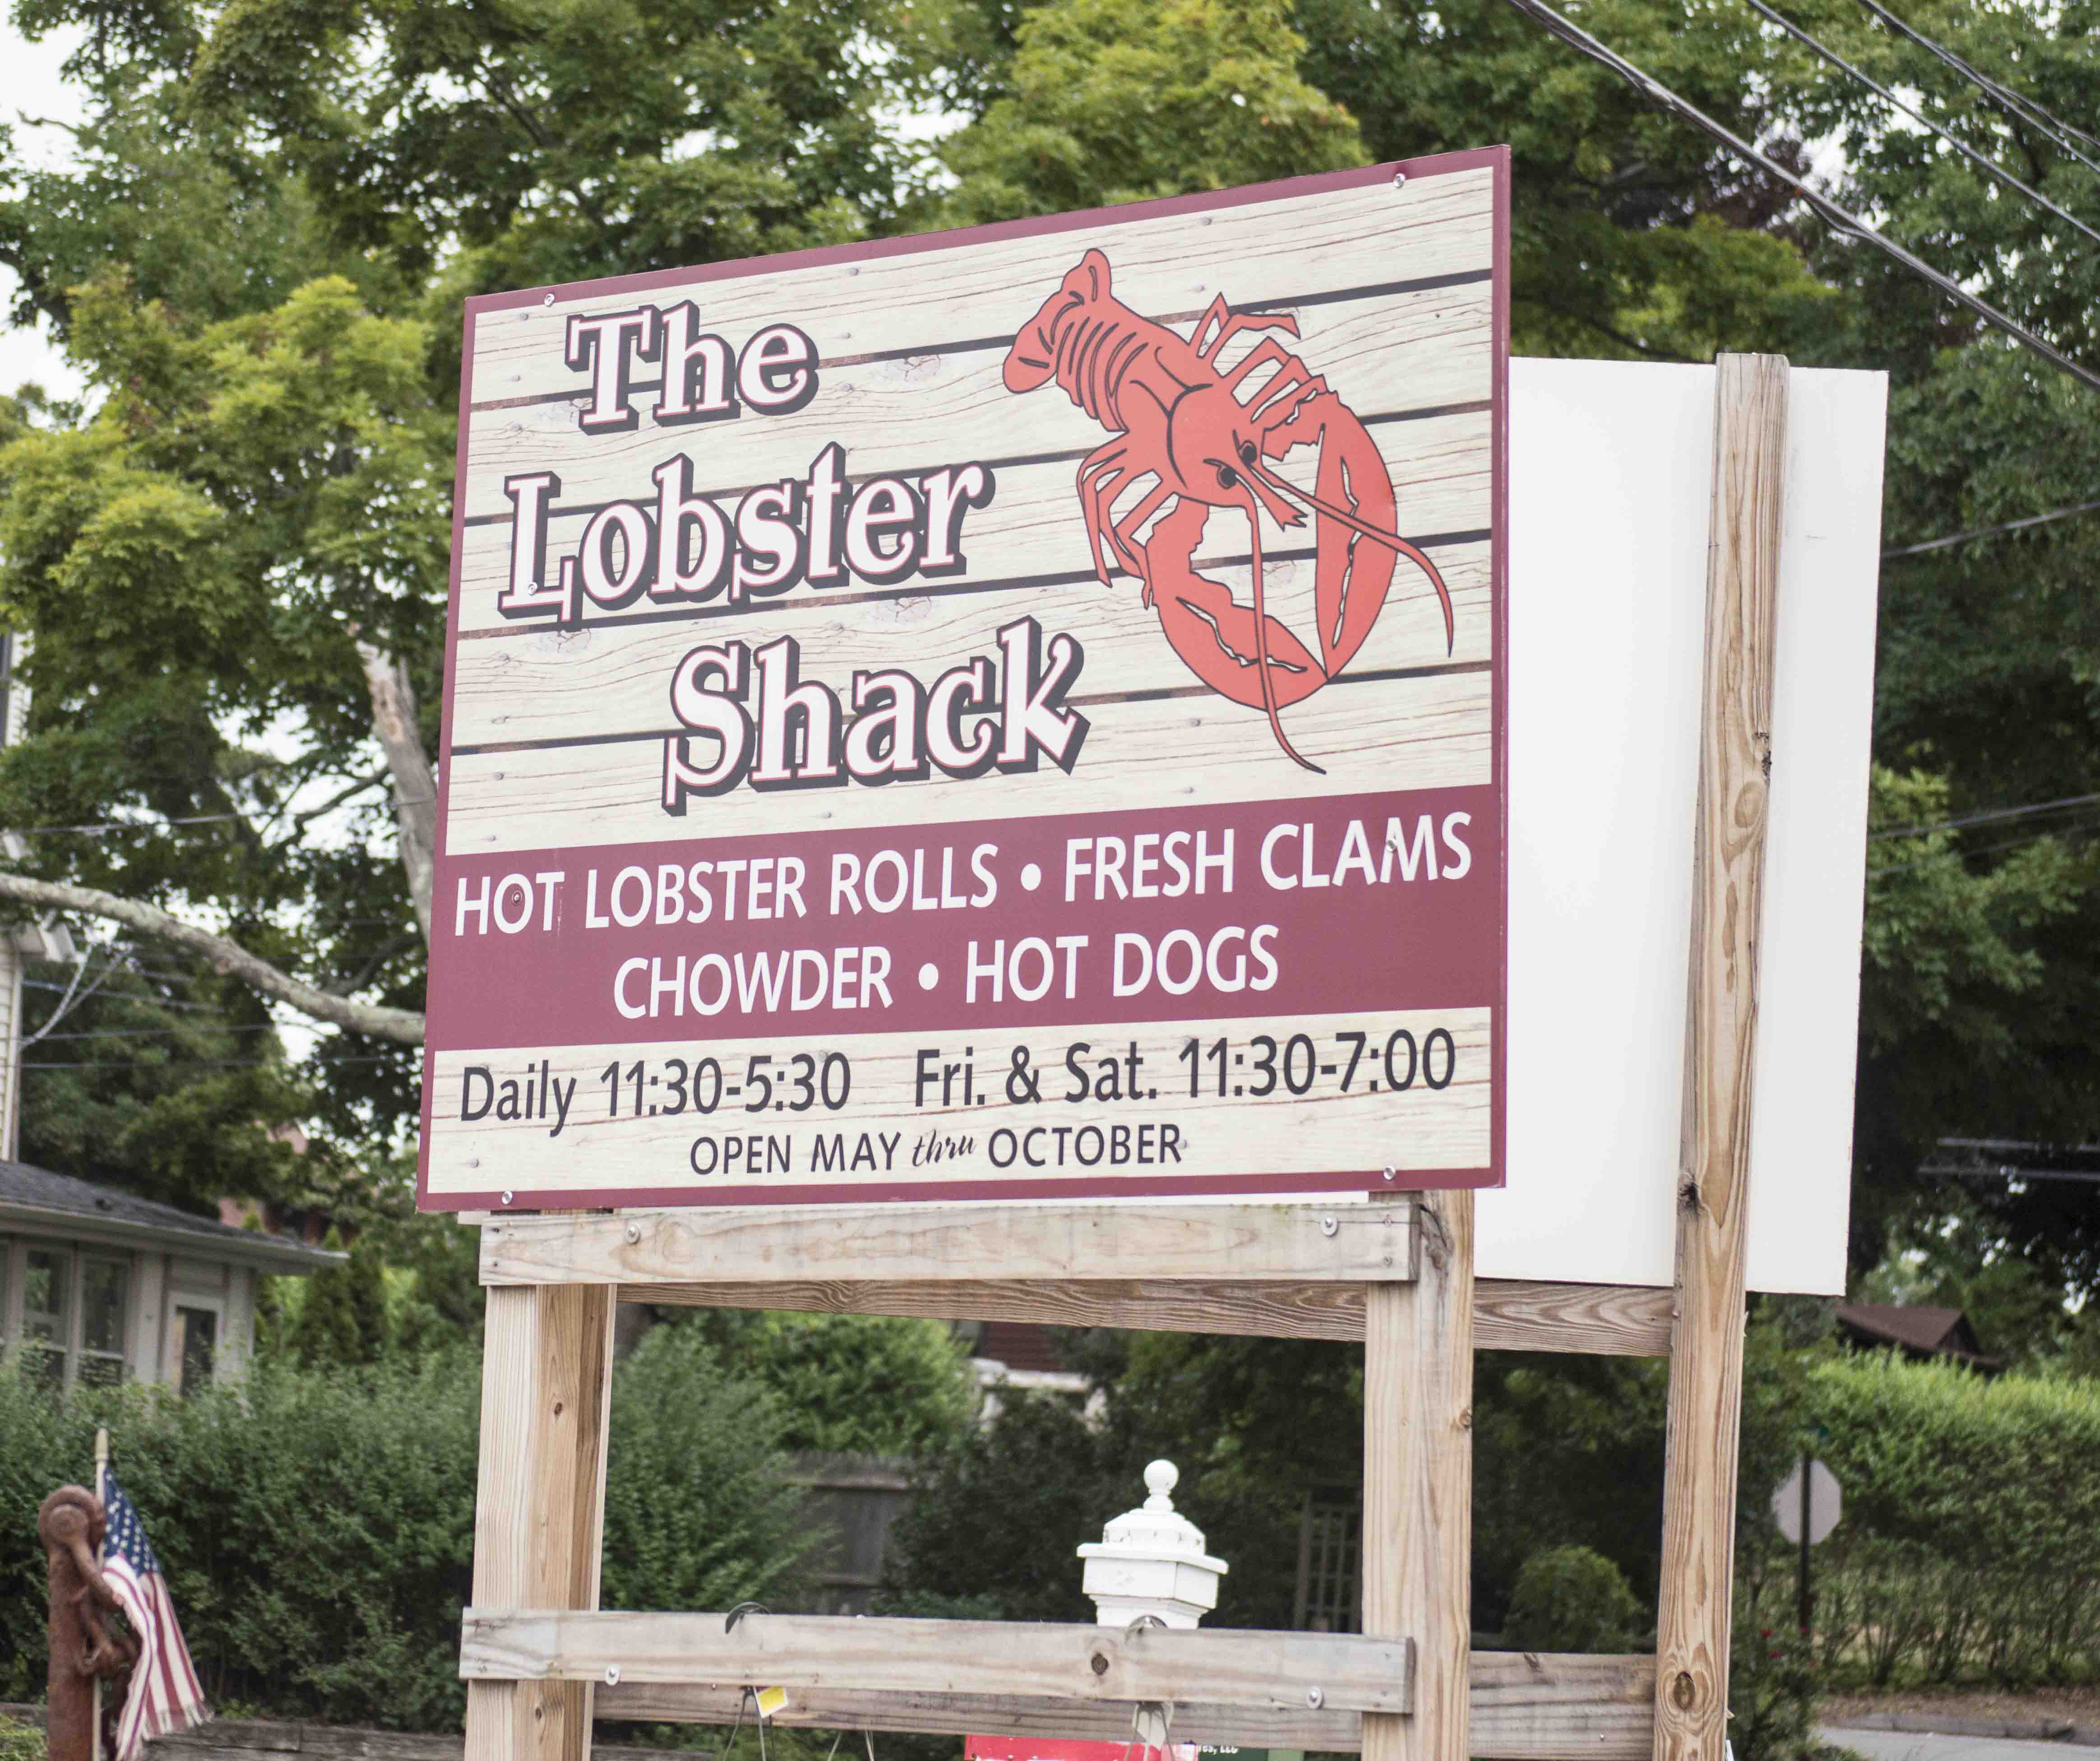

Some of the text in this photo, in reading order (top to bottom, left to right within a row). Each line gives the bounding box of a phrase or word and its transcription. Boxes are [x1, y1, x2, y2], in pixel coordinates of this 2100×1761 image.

[566, 300, 819, 434] The
[498, 442, 995, 630] Lobster
[661, 616, 1091, 816] Shack
[455, 812, 1472, 936] HOT LOBSTER ROLLS FRESH CLAMS
[614, 924, 1279, 1019] CHOWDER HOT DOGS
[461, 1028, 1456, 1137] Daily 11:30-5:30 Fri. & Sat. 11:30-7:00
[690, 1123, 1182, 1175] OPEN MAY thru OCTOBER
